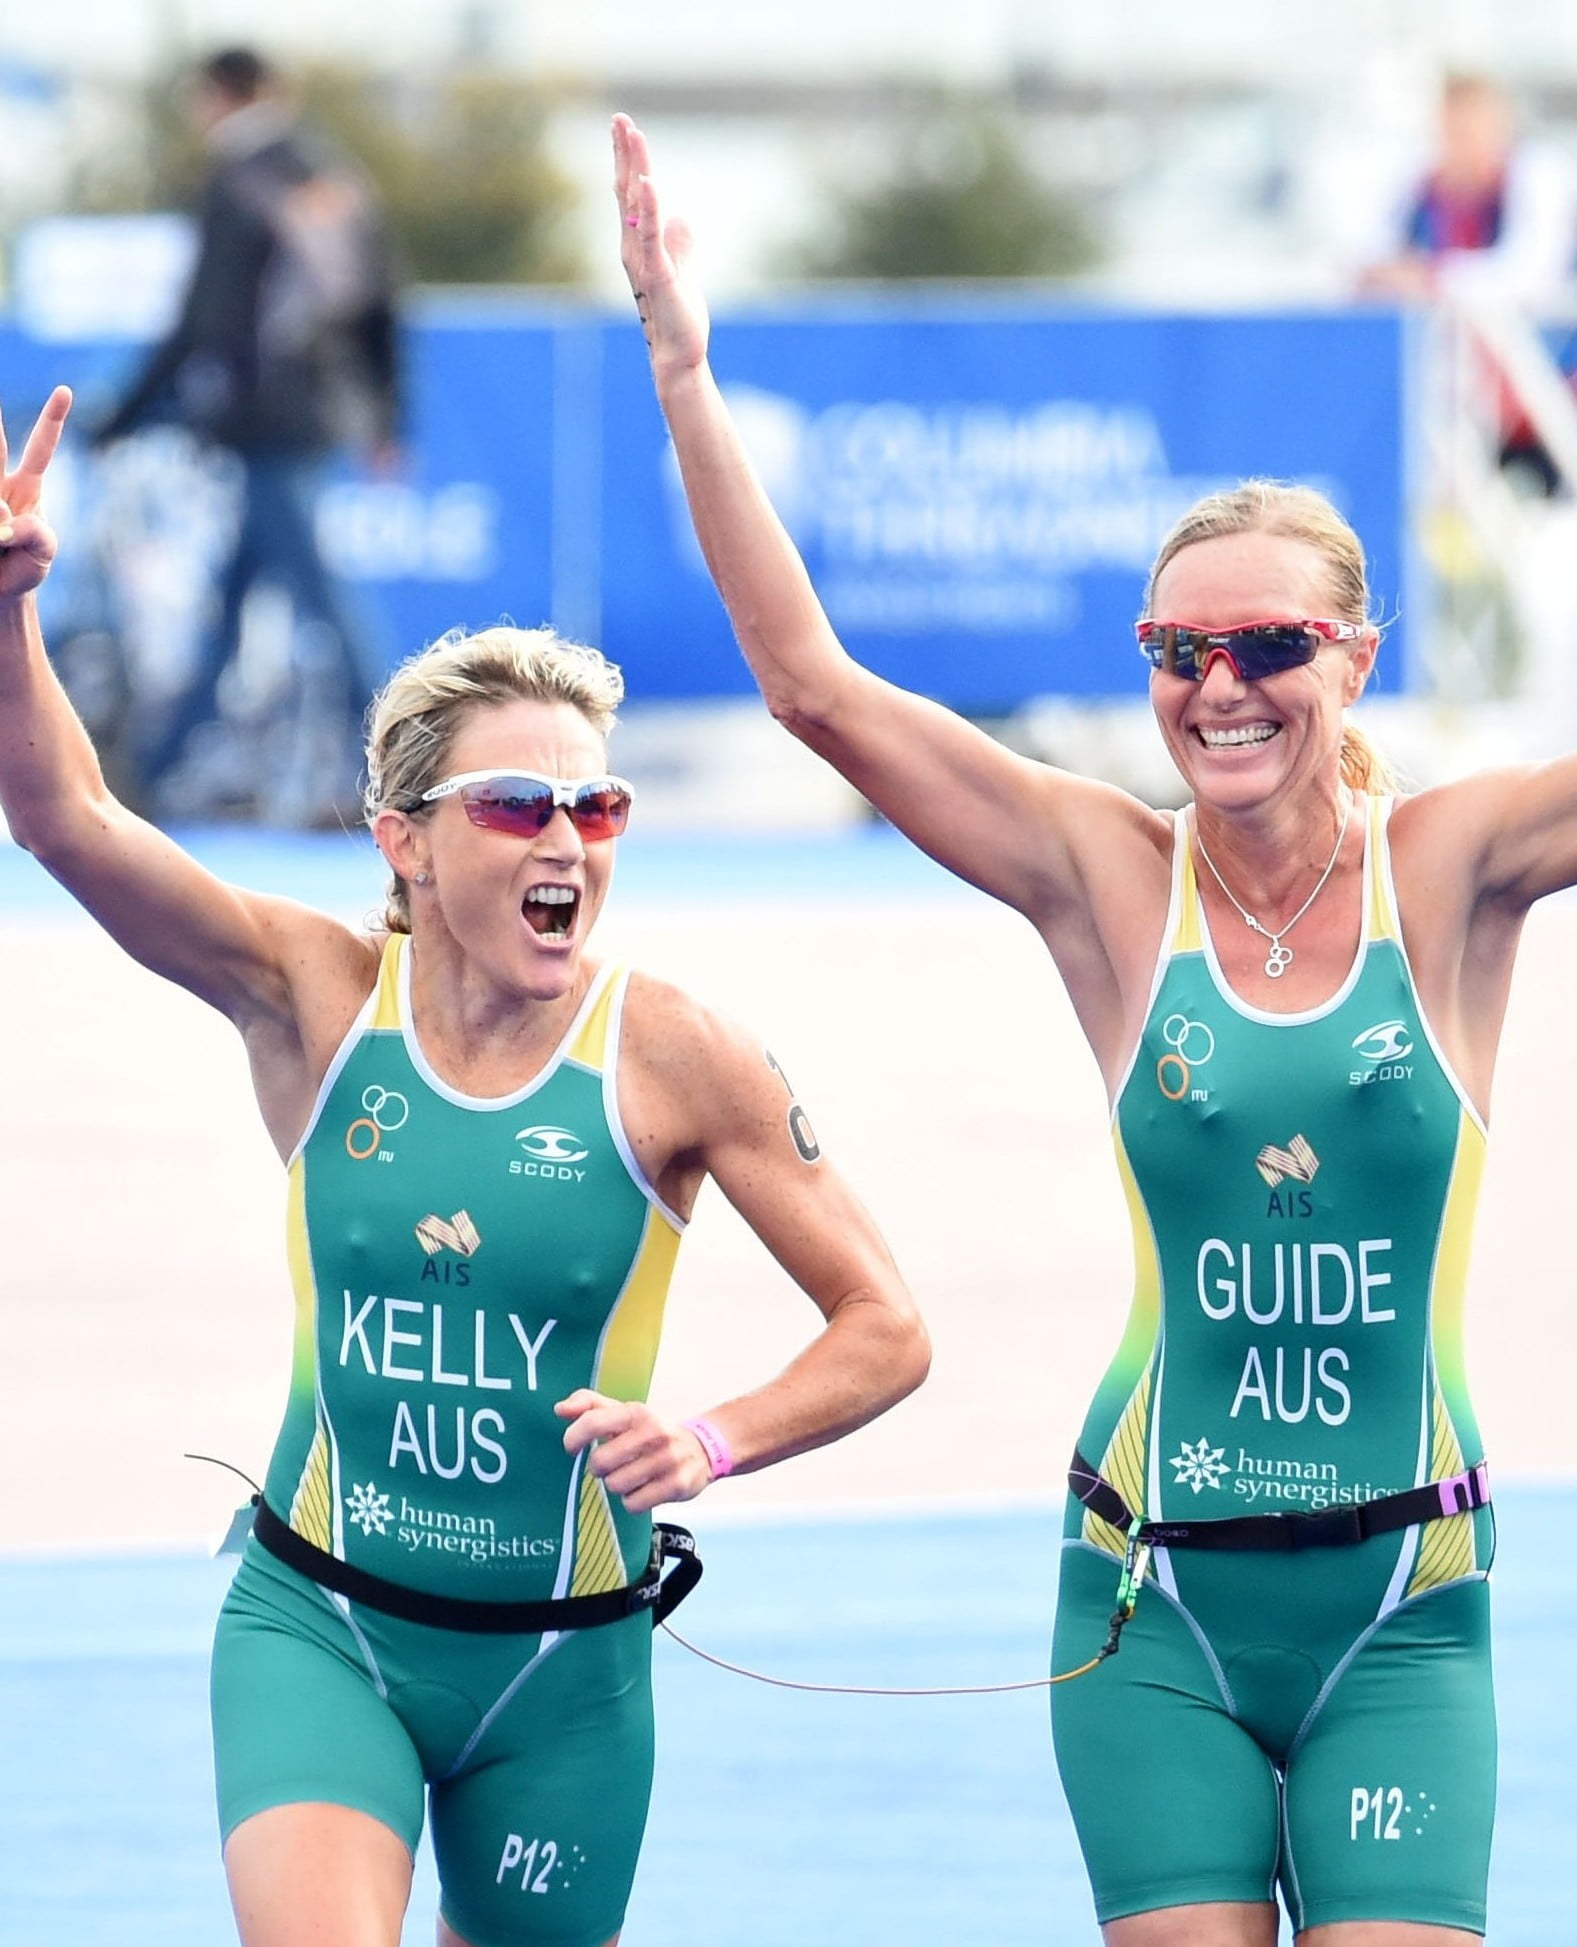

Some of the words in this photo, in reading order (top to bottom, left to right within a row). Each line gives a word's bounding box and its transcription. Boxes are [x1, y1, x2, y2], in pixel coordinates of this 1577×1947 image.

[1350, 1065, 1413, 1086] SCODY
[1191, 1089, 1208, 1102] ITU
[378, 1150, 394, 1163] ITU
[509, 1160, 585, 1183] SCODY
[1267, 1190, 1313, 1219] AIS
[421, 1258, 471, 1287] AIS
[1197, 1238, 1396, 1325] GUIDE
[339, 1289, 558, 1391] KELLY
[1229, 1346, 1351, 1427] AUS
[388, 1400, 508, 1484] AUS
[1236, 1448, 1338, 1481] human
[399, 1497, 496, 1535] human
[397, 1529, 555, 1562] synergistics
[1350, 1786, 1403, 1841] P12
[496, 1833, 558, 1894] P12
